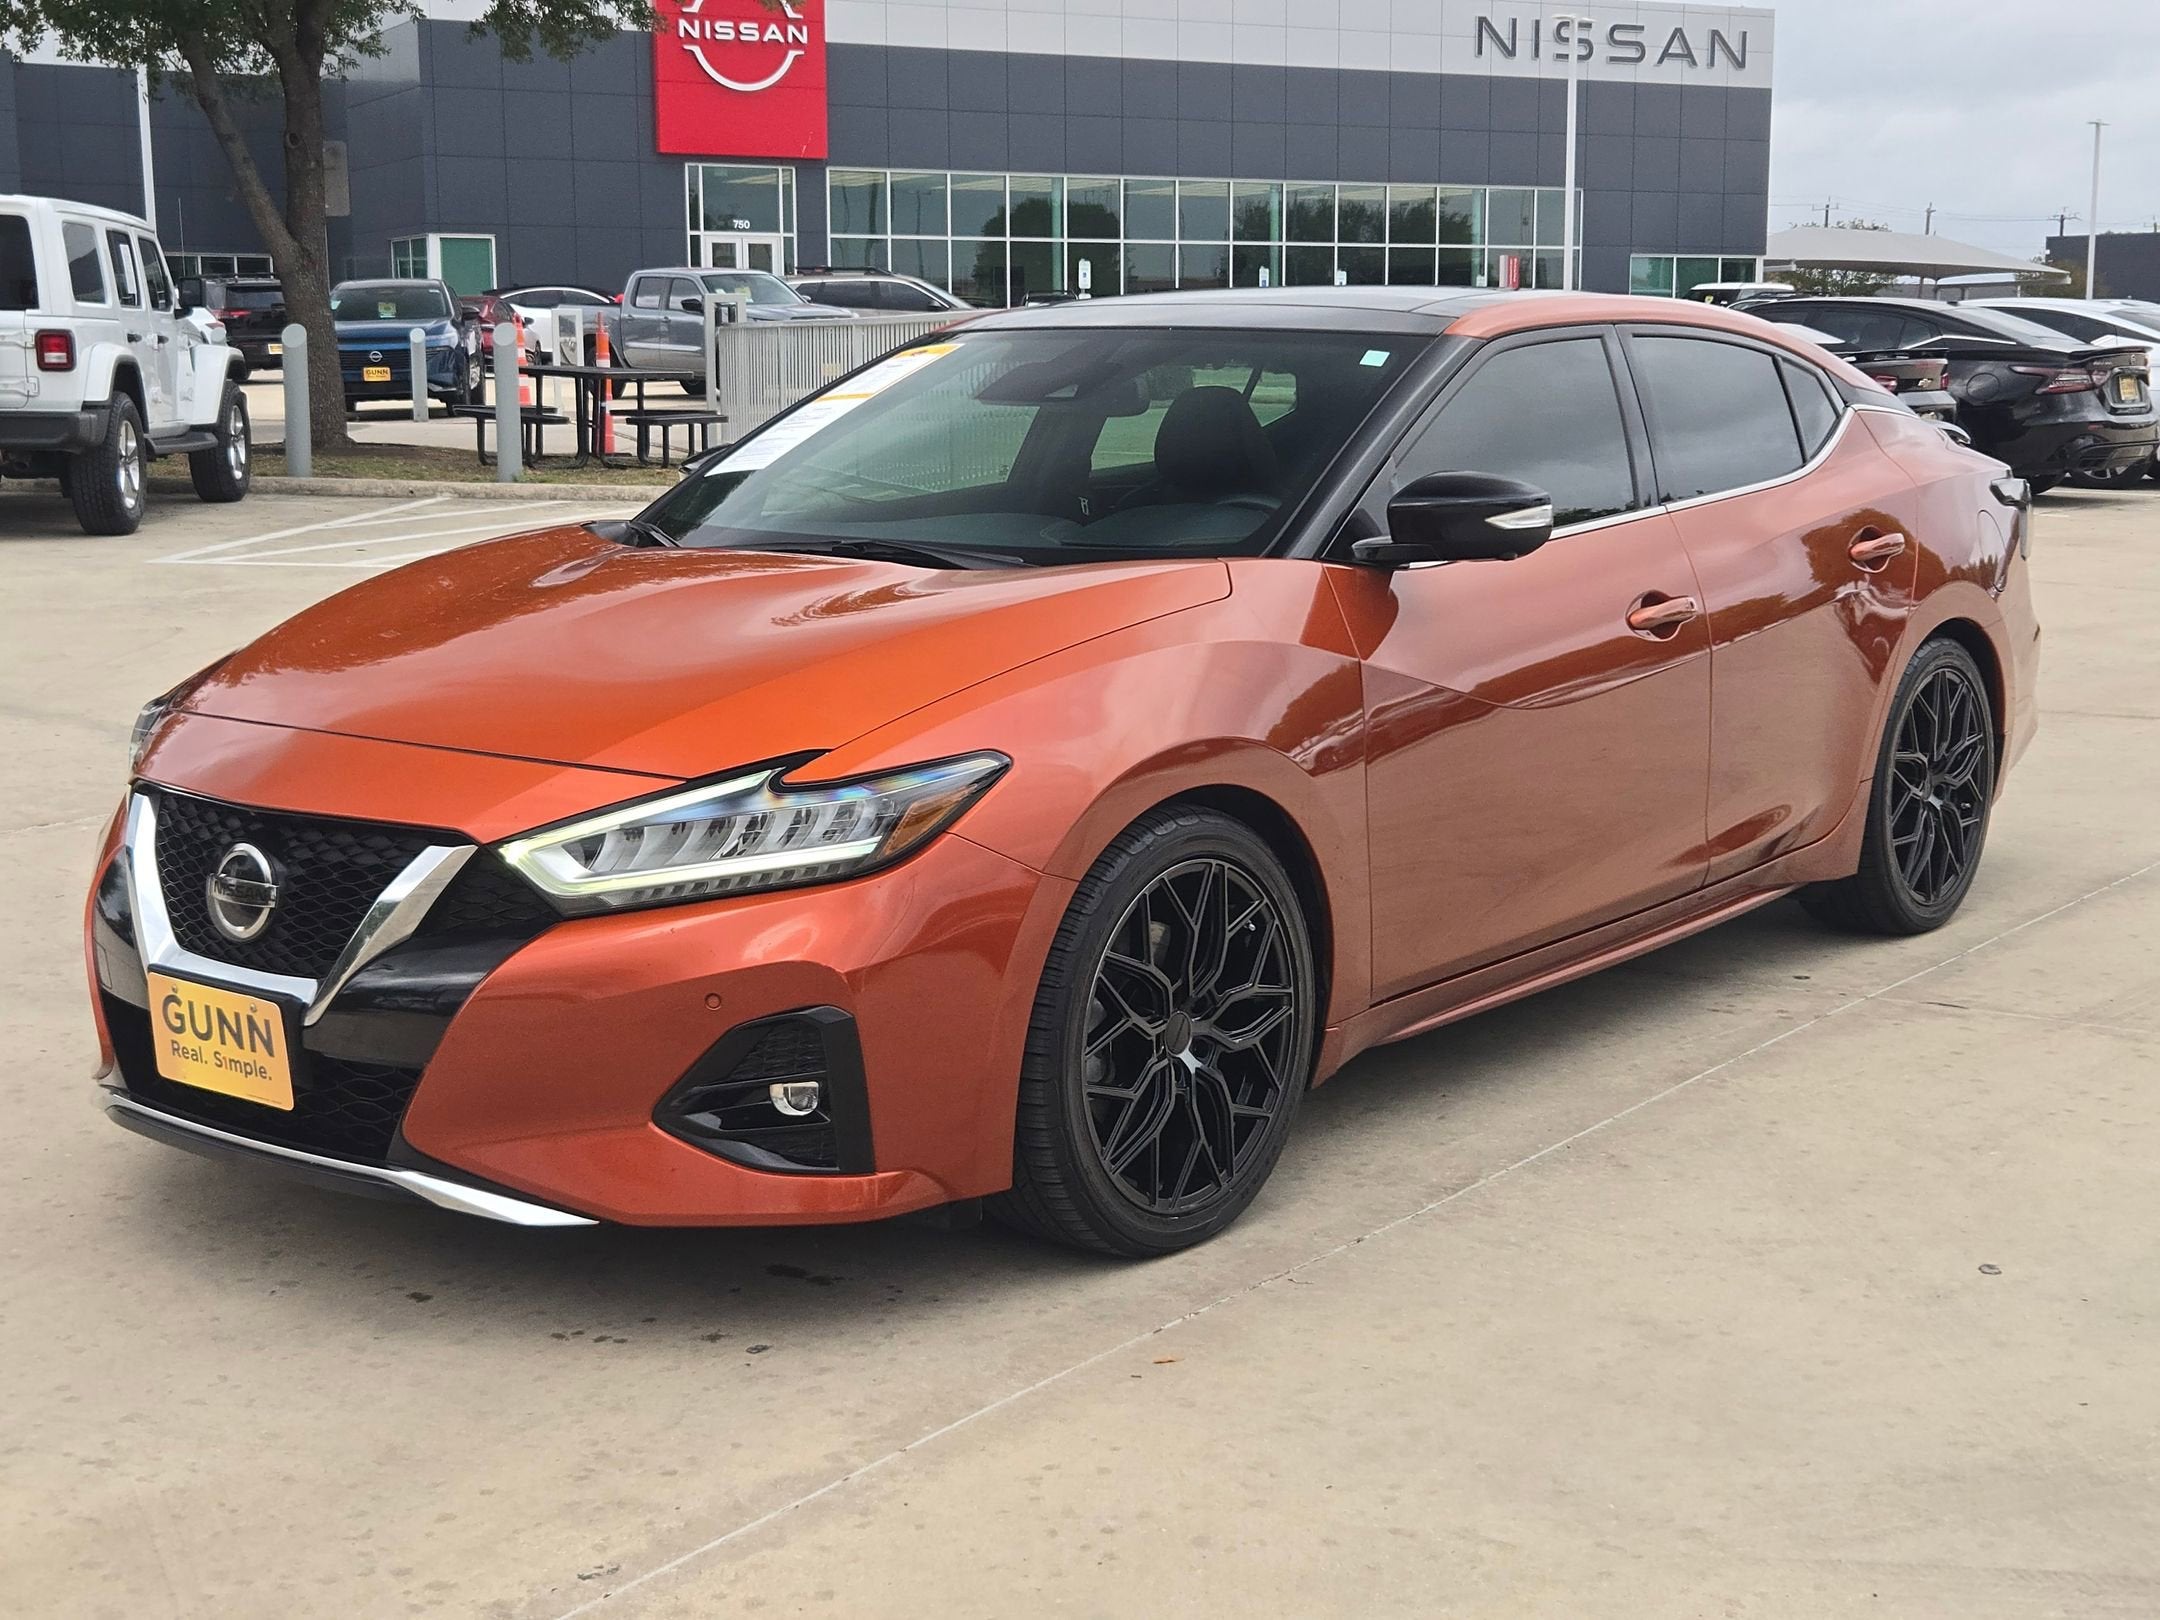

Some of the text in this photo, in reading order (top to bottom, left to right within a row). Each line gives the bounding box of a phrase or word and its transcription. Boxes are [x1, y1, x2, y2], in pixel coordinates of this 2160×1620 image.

[678, 18, 808, 44] NISSAN
[1475, 16, 1748, 70] NISSAN
[733, 219, 750, 229] 750
[162, 994, 275, 1058] GUNN
[170, 1039, 208, 1065] Real.
